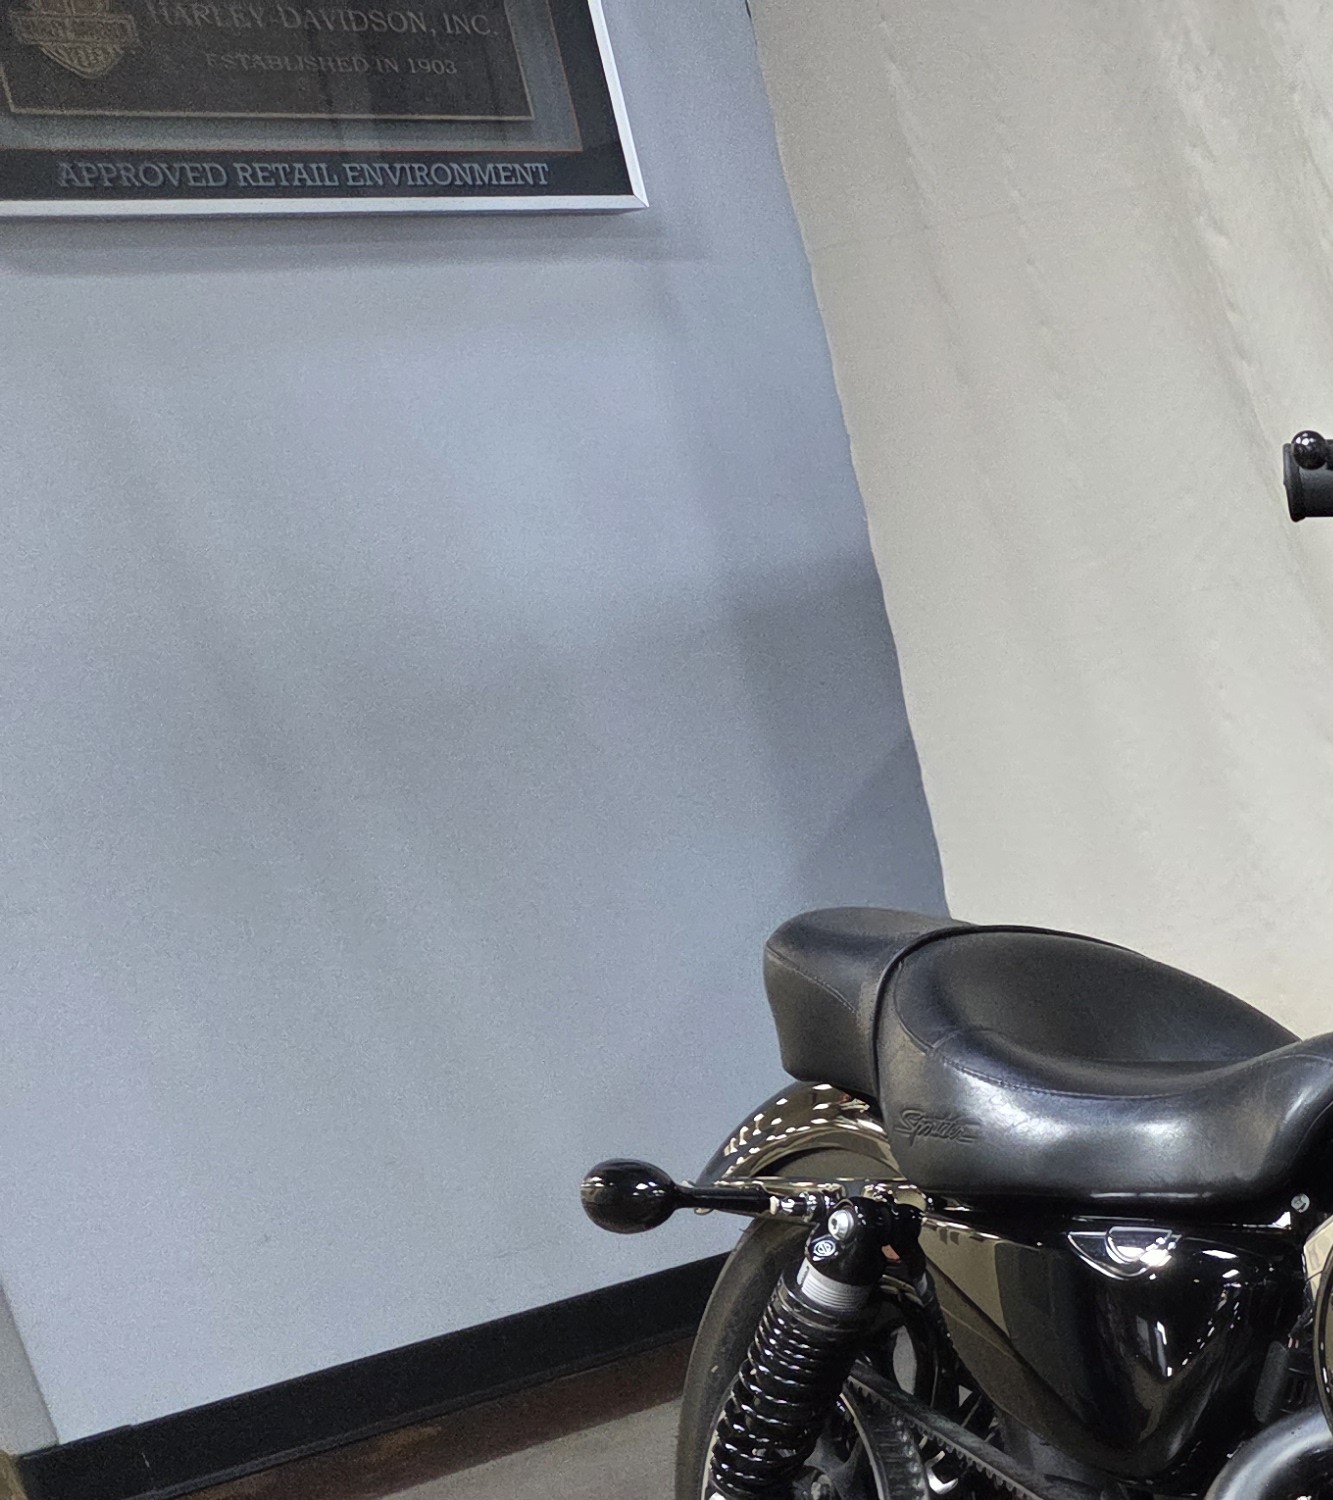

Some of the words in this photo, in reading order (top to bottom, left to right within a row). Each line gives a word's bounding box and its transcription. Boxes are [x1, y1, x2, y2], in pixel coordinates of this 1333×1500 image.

[205, 53, 368, 73] ESTABLISHED
[375, 57, 399, 72] IN
[408, 58, 457, 75] 1903
[58, 161, 228, 188] APPROVED
[235, 161, 339, 188] RETAIL
[345, 161, 549, 187] ENVIRONMENT
